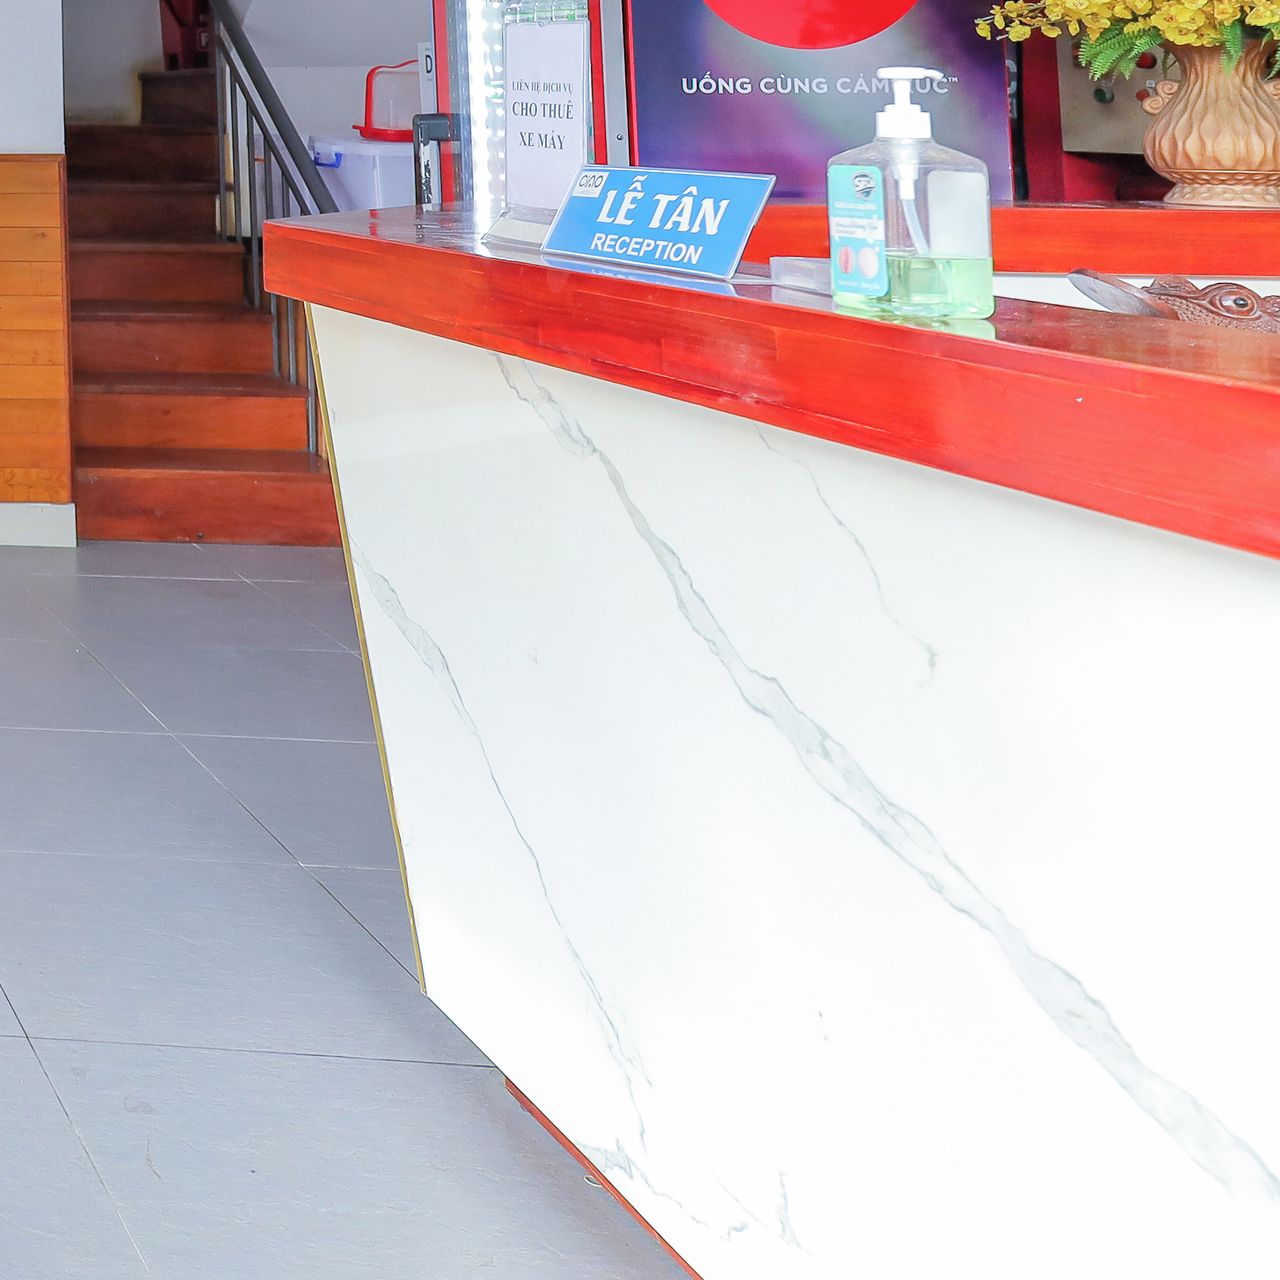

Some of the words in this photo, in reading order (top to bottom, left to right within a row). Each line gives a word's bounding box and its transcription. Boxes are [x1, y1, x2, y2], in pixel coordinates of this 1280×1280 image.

[512, 79, 530, 91] LIÊN
[531, 80, 541, 94] HỆ
[543, 82, 562, 95] DỊCH
[563, 82, 574, 96] VỤ
[681, 71, 752, 95] UỐNG
[759, 73, 828, 95] CÙNG
[512, 101, 538, 118] CHO
[540, 99, 574, 120] THUÊ
[519, 131, 535, 147] XE
[537, 129, 566, 150] MÁY
[596, 174, 648, 226] LỄ
[648, 185, 731, 236] TÂN
[590, 232, 703, 265] RECEPTION
